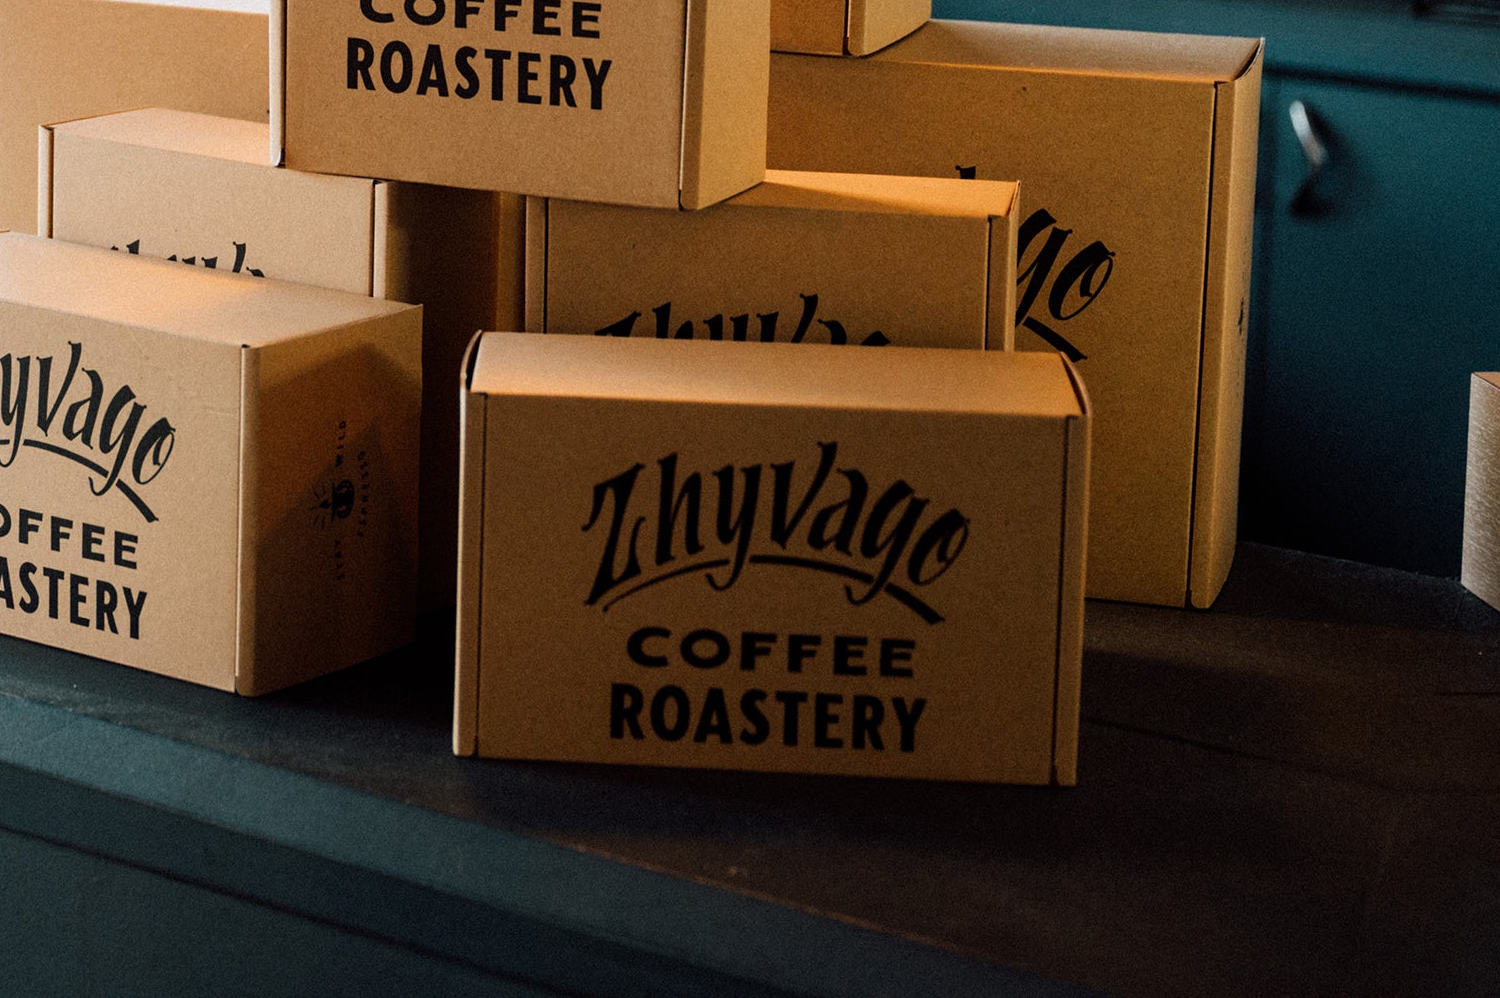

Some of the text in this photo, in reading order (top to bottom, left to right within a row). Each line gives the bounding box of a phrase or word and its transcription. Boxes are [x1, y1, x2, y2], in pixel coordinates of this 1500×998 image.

[345, 36, 613, 111] ROASTERY
[334, 419, 347, 468] WILD
[580, 440, 972, 608] Zhyvago
[625, 625, 918, 680] COFFEE
[607, 681, 929, 756] ROASTERY
